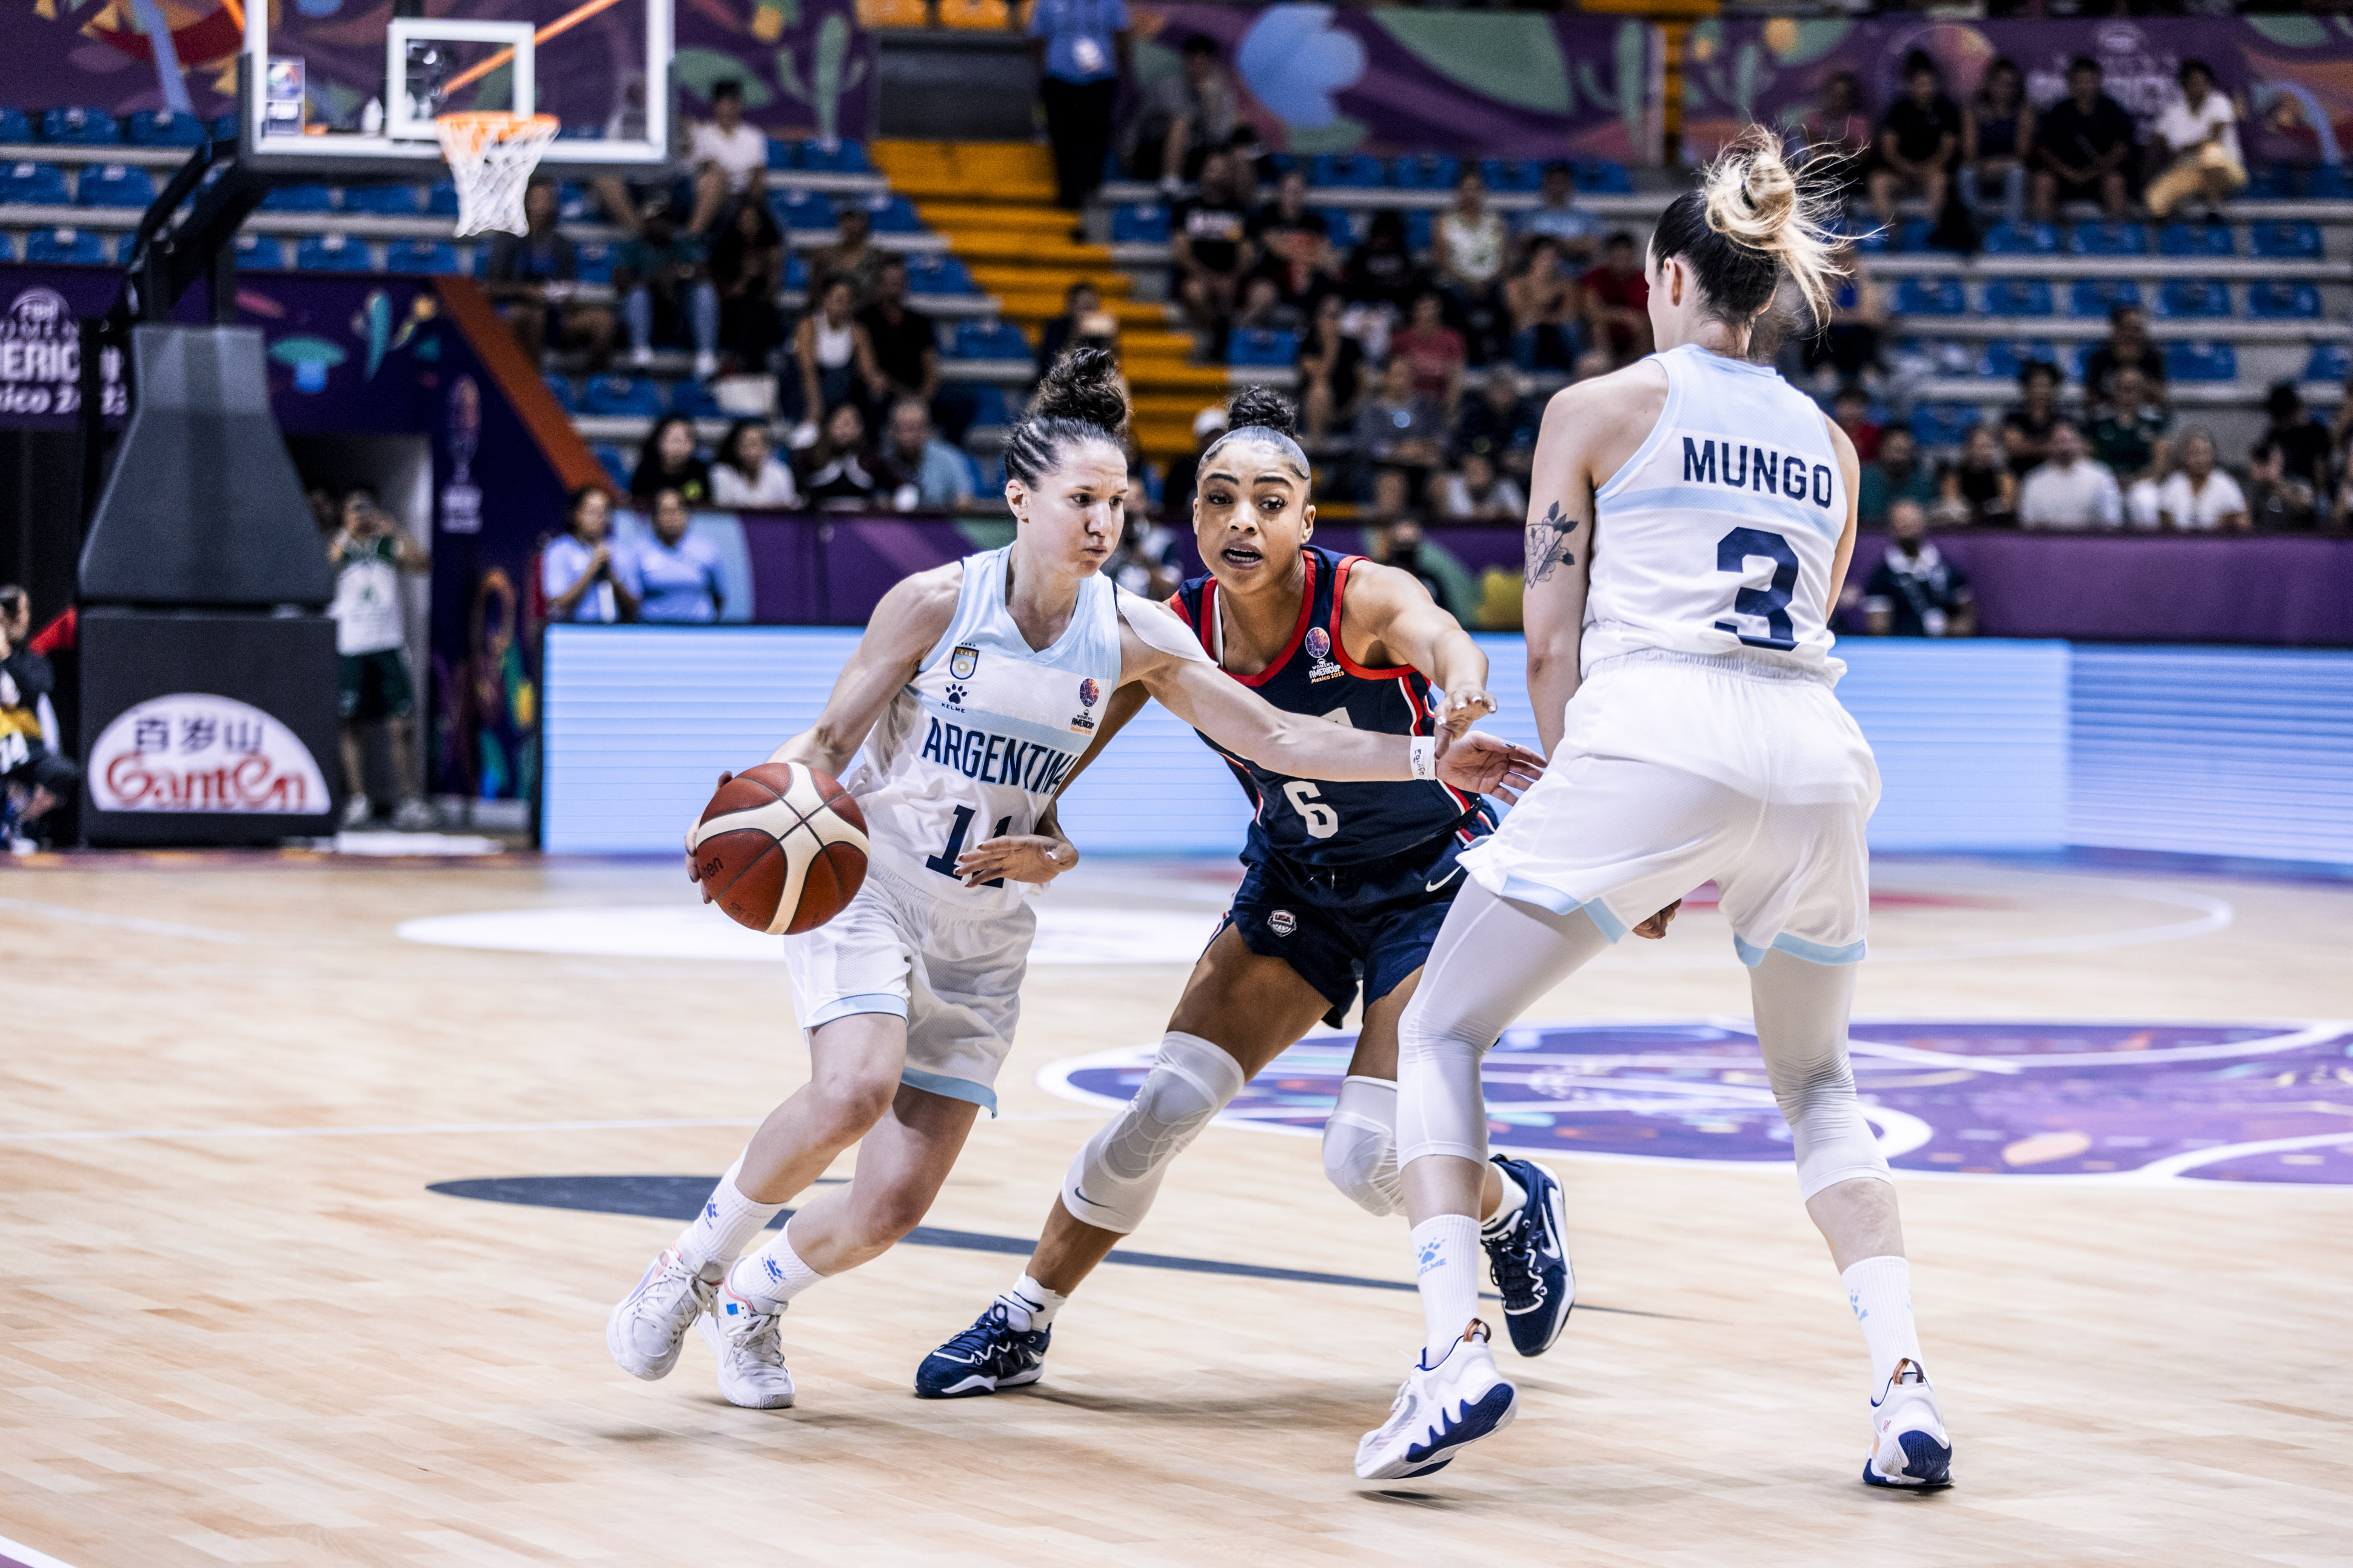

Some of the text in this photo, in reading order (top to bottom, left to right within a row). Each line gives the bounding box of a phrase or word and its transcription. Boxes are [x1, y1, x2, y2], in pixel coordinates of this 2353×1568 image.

[1683, 437, 1831, 509] MUNGO
[1715, 527, 1801, 652] 3
[1309, 664, 1341, 678] AMERICUP
[1311, 675, 1330, 684] Mexico
[942, 703, 965, 713] KELME
[135, 713, 263, 756] 百岁山
[1413, 749, 1425, 776] Equipo
[1282, 780, 1339, 839] 6
